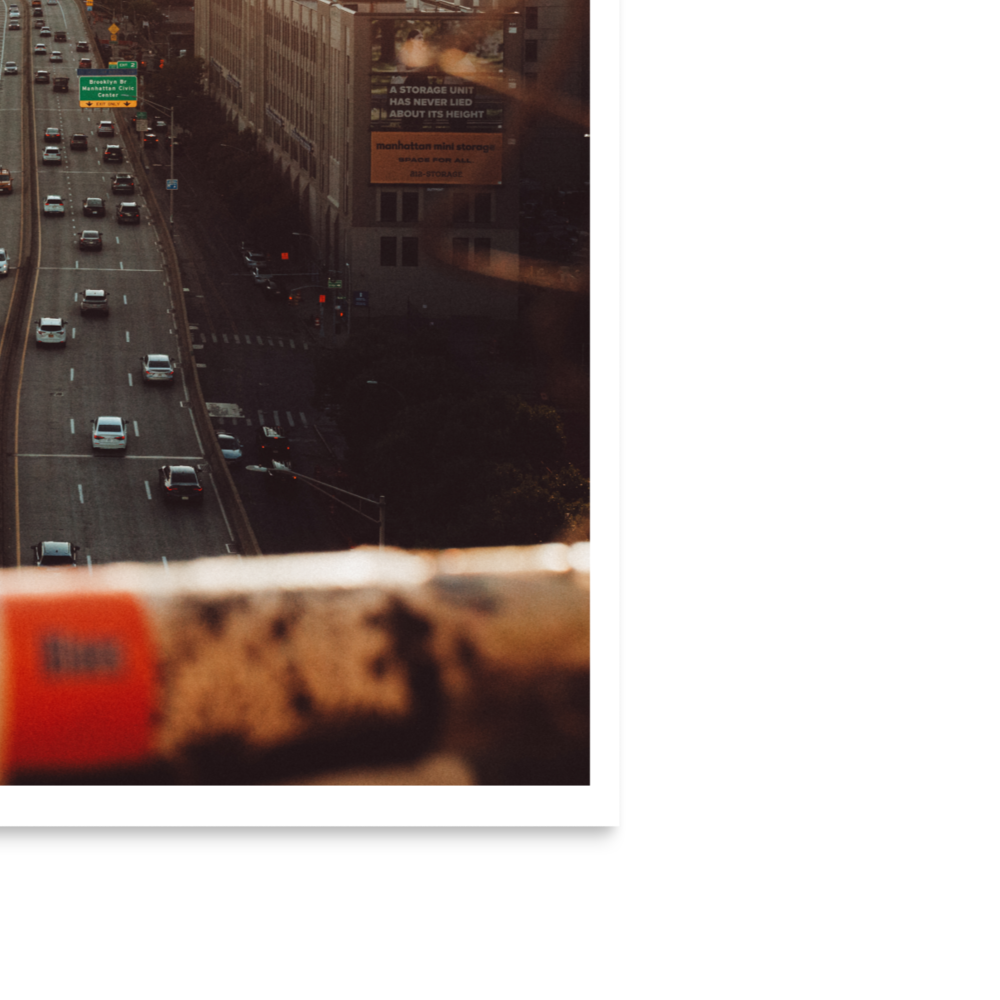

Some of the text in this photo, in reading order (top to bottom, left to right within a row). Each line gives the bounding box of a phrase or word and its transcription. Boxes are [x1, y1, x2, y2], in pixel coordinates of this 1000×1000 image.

[399, 86, 447, 94] STORAGE
[376, 140, 432, 150] manhattan
[456, 143, 495, 153] storage
